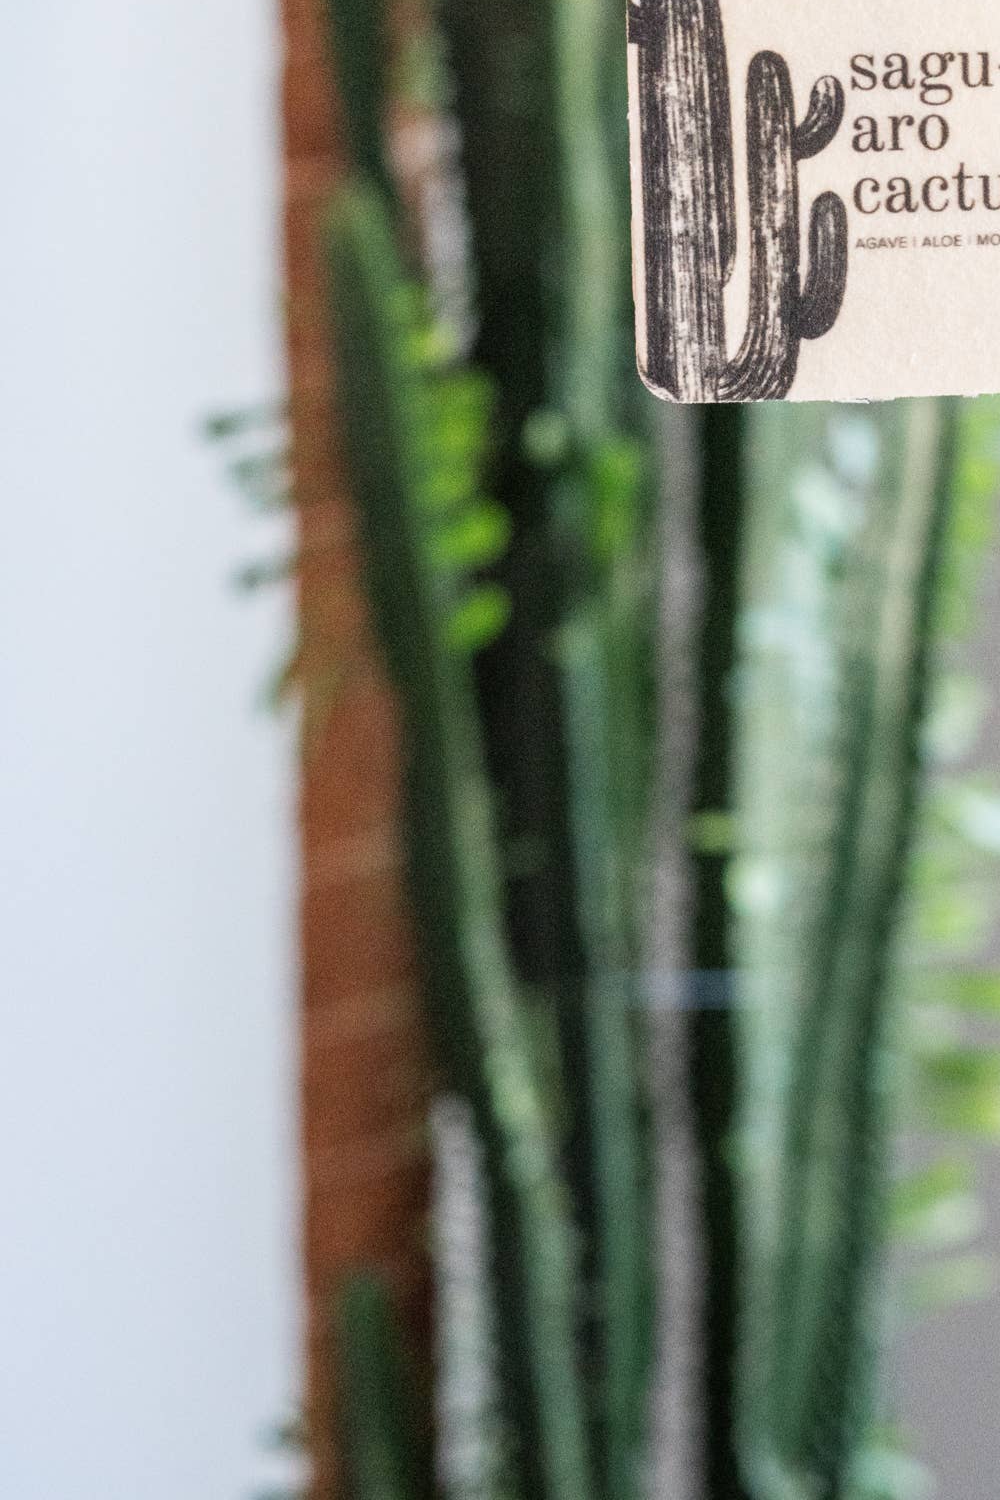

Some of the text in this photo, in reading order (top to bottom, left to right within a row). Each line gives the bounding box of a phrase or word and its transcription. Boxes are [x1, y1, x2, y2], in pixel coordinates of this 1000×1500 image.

[851, 114, 950, 153] aro
[855, 235, 908, 250] AGAVE
[921, 234, 963, 248] ALOE
